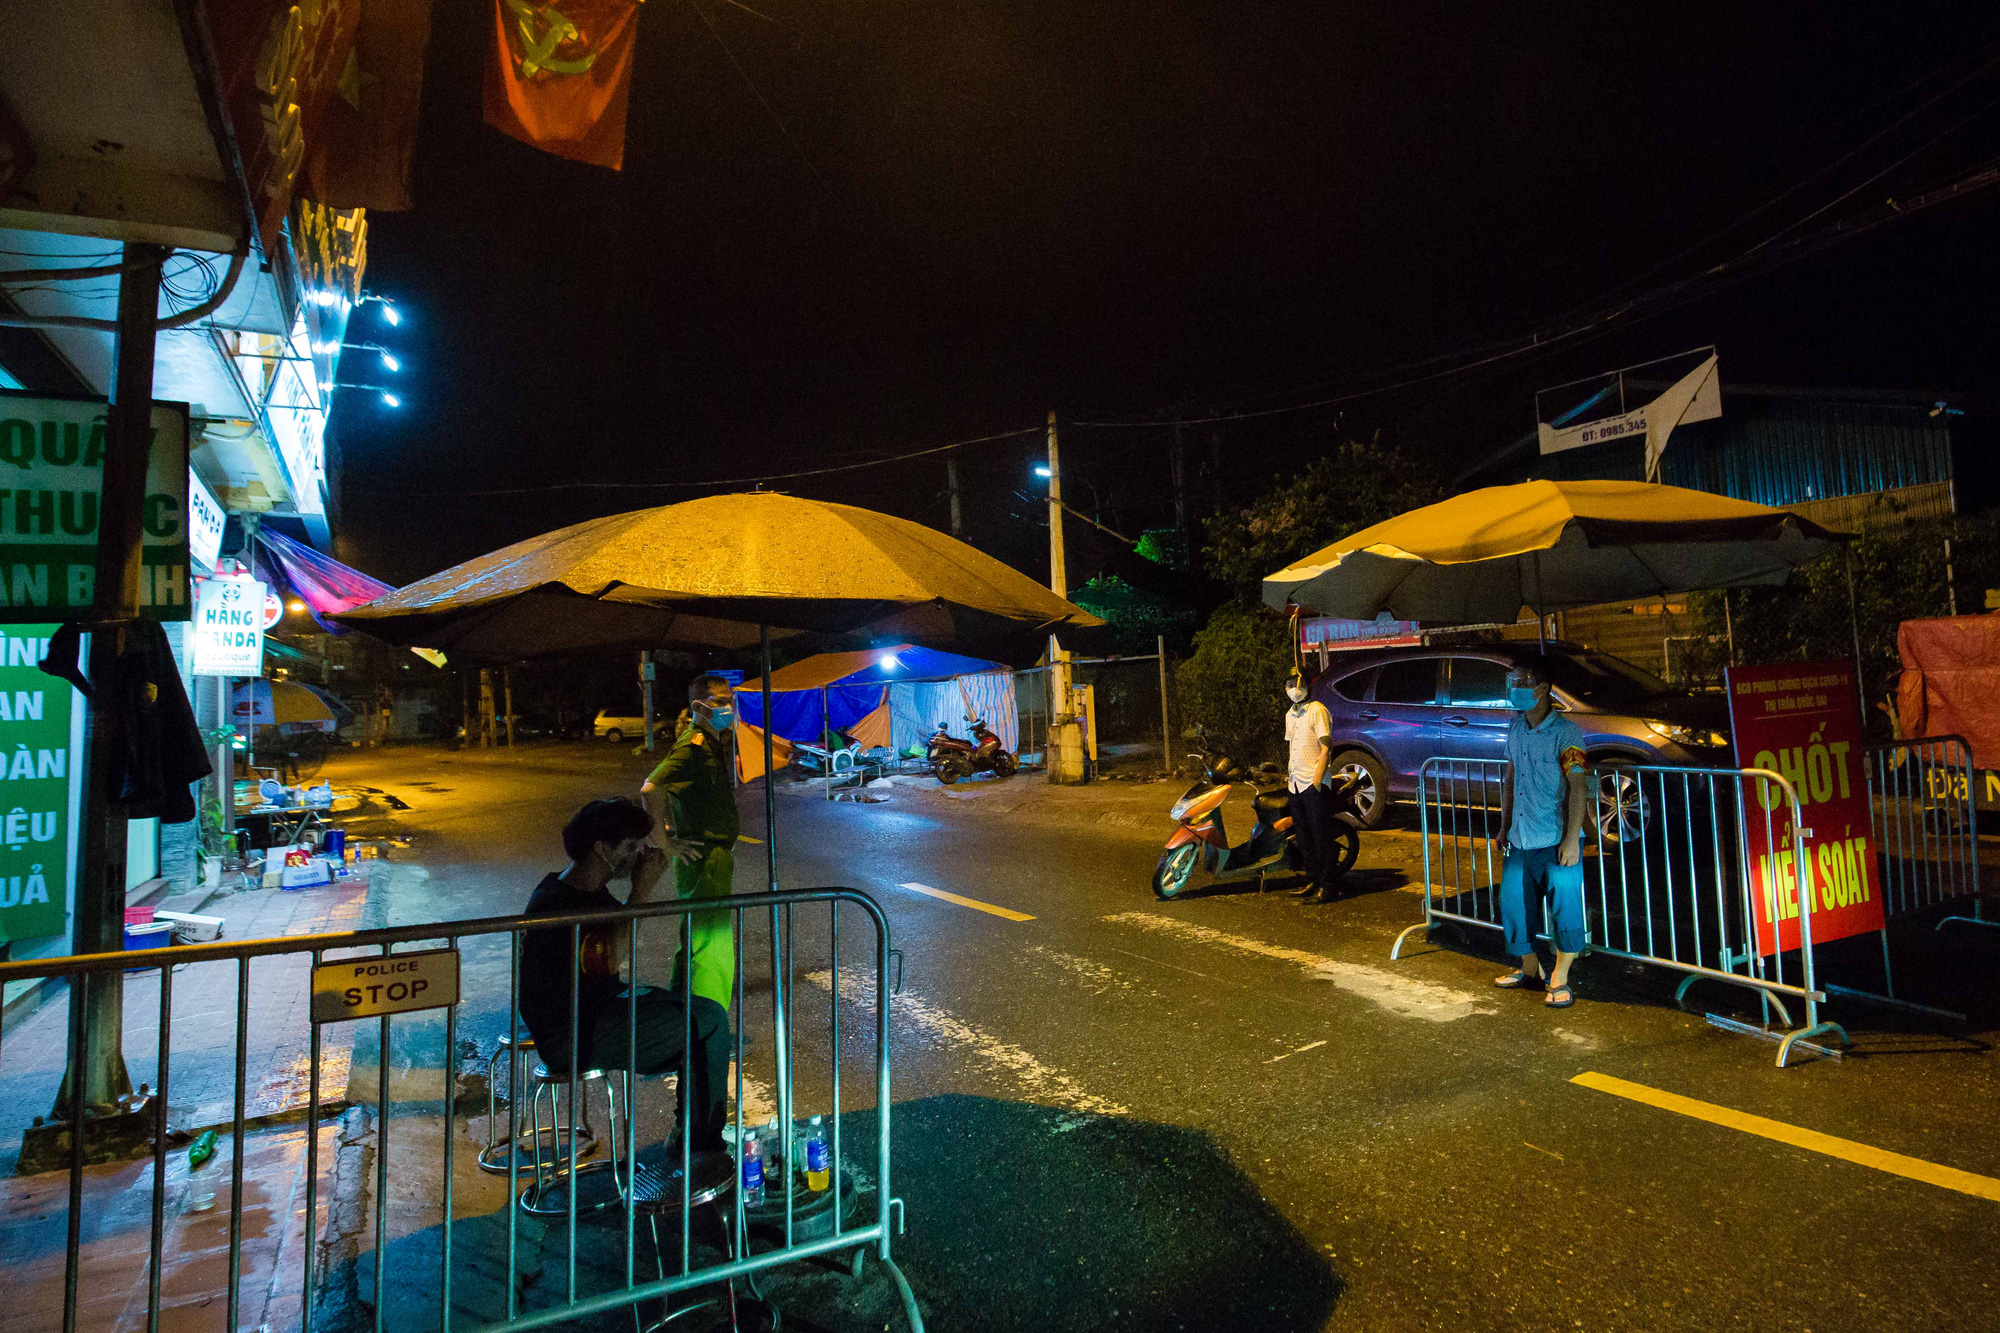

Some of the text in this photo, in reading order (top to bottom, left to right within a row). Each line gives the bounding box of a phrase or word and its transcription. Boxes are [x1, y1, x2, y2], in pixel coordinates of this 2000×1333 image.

[0, 488, 179, 538] HUC
[202, 630, 257, 648] ANDA
[1753, 721, 1851, 812] CHỐT
[1818, 824, 1870, 911] SOÁT
[354, 960, 420, 978] POLICE
[343, 979, 429, 1007] STOP
